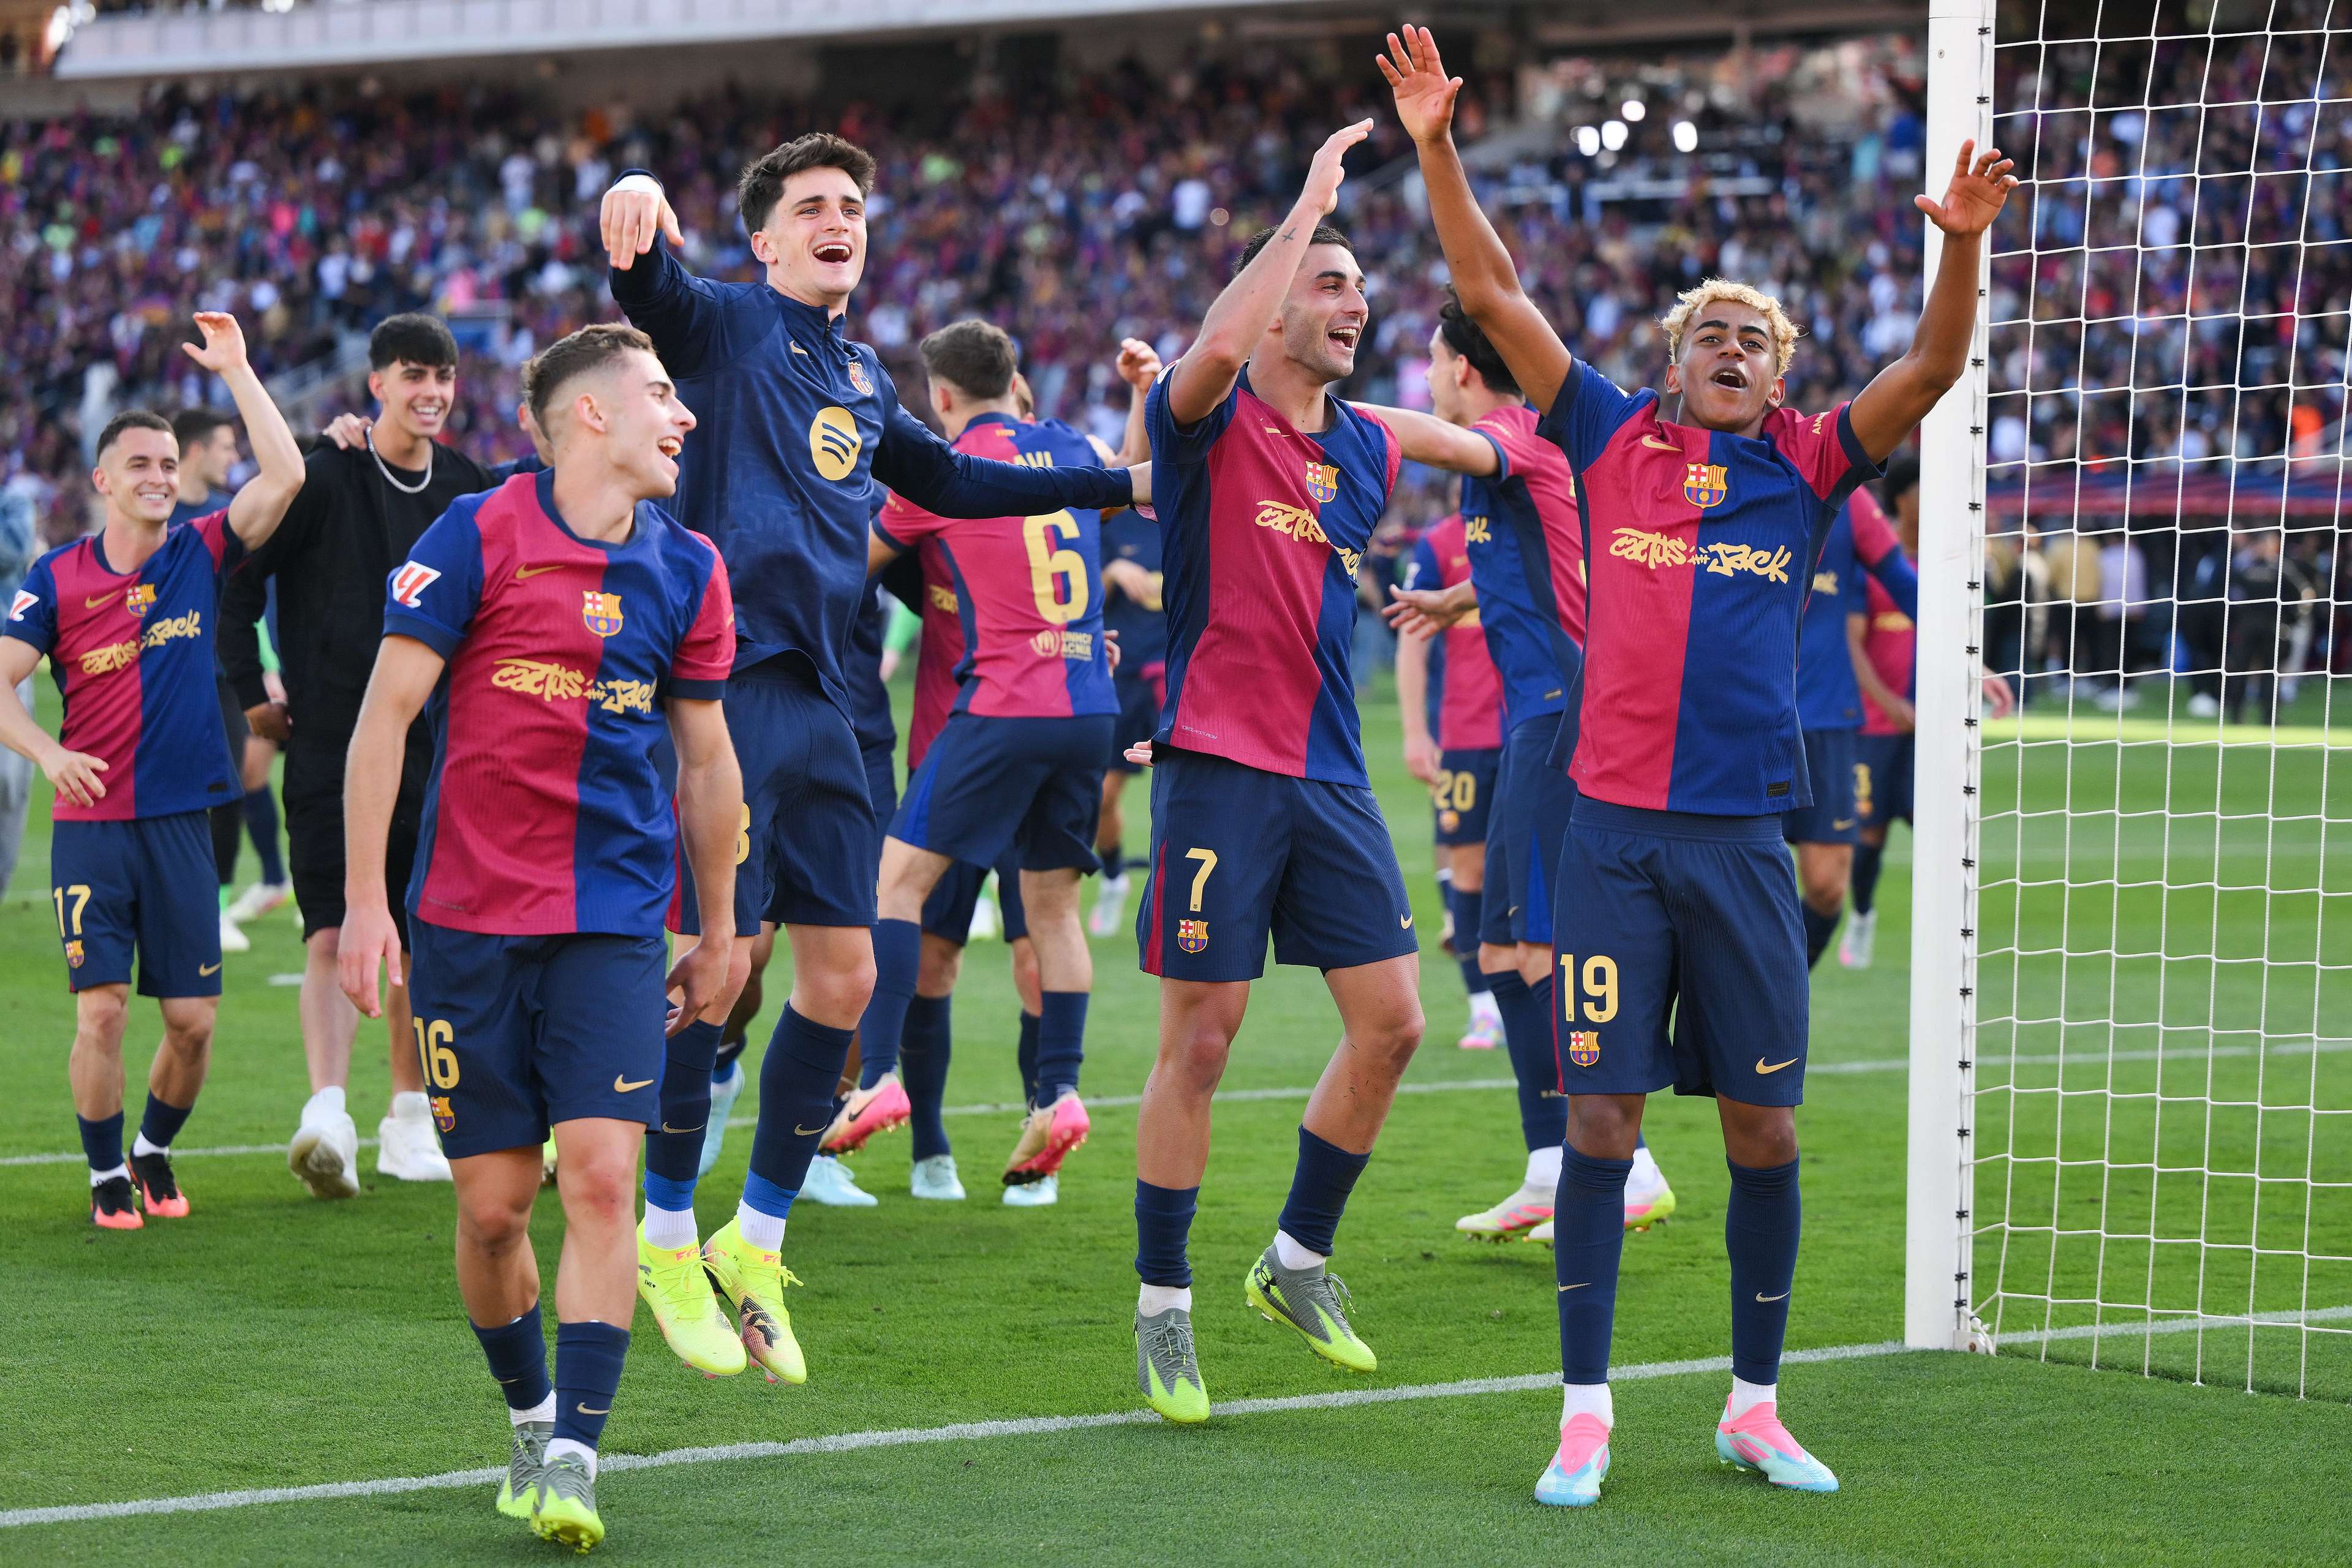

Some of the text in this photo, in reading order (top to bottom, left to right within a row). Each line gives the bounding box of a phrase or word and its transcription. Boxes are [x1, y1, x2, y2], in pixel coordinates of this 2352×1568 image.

[1023, 508, 1088, 625] 6
[1434, 769, 1477, 812] 20
[54, 884, 91, 938] 17
[1185, 848, 1218, 911] 7
[1560, 954, 1618, 1023] 19
[413, 1017, 460, 1089] 16
